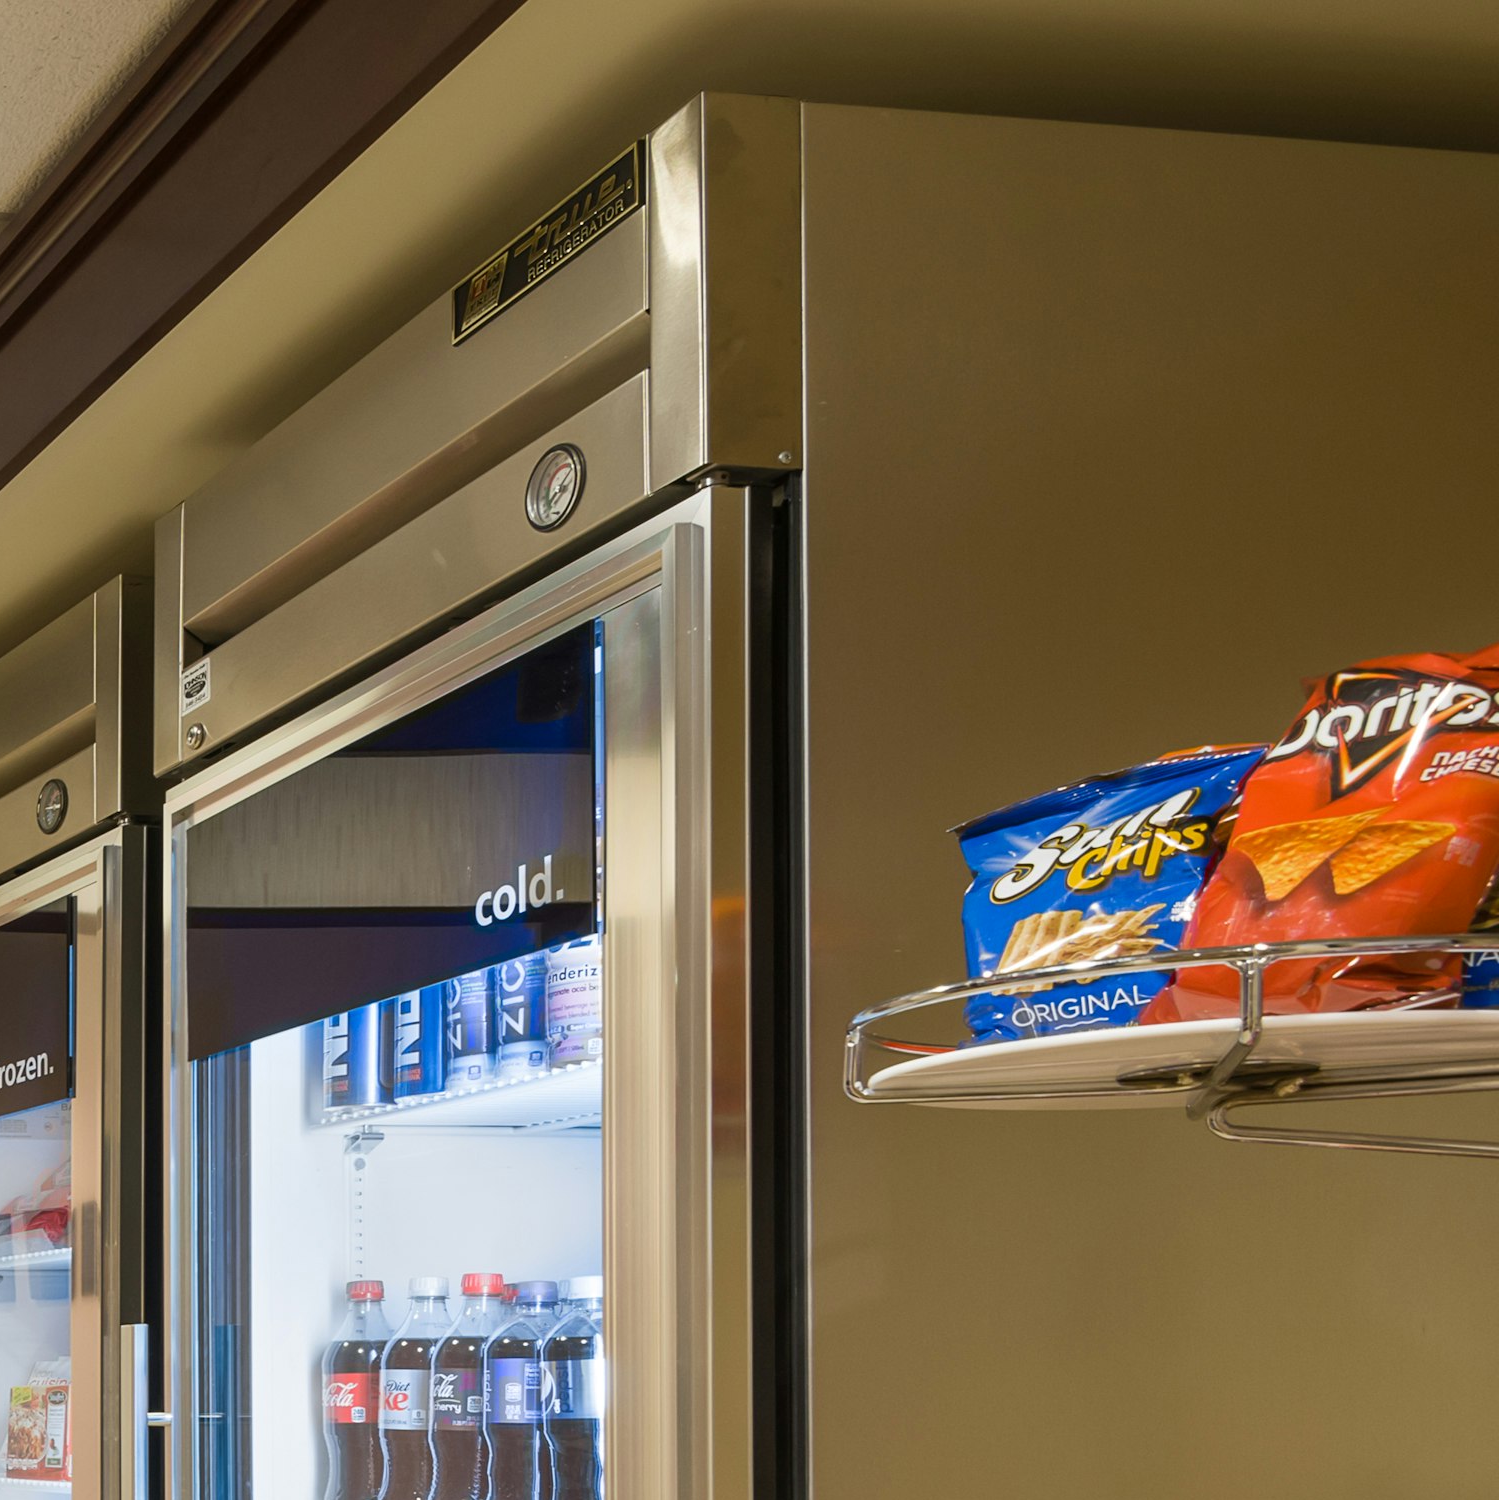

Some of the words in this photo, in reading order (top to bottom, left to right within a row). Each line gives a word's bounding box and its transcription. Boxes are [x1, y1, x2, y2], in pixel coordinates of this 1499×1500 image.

[527, 199, 625, 283] REFRIGERATOR
[990, 787, 1201, 904] Sun
[1066, 822, 1209, 892] Chips
[474, 855, 565, 927] cold.
[1012, 984, 1153, 1028] ORIGINAL
[386, 1380, 411, 1392] Diet
